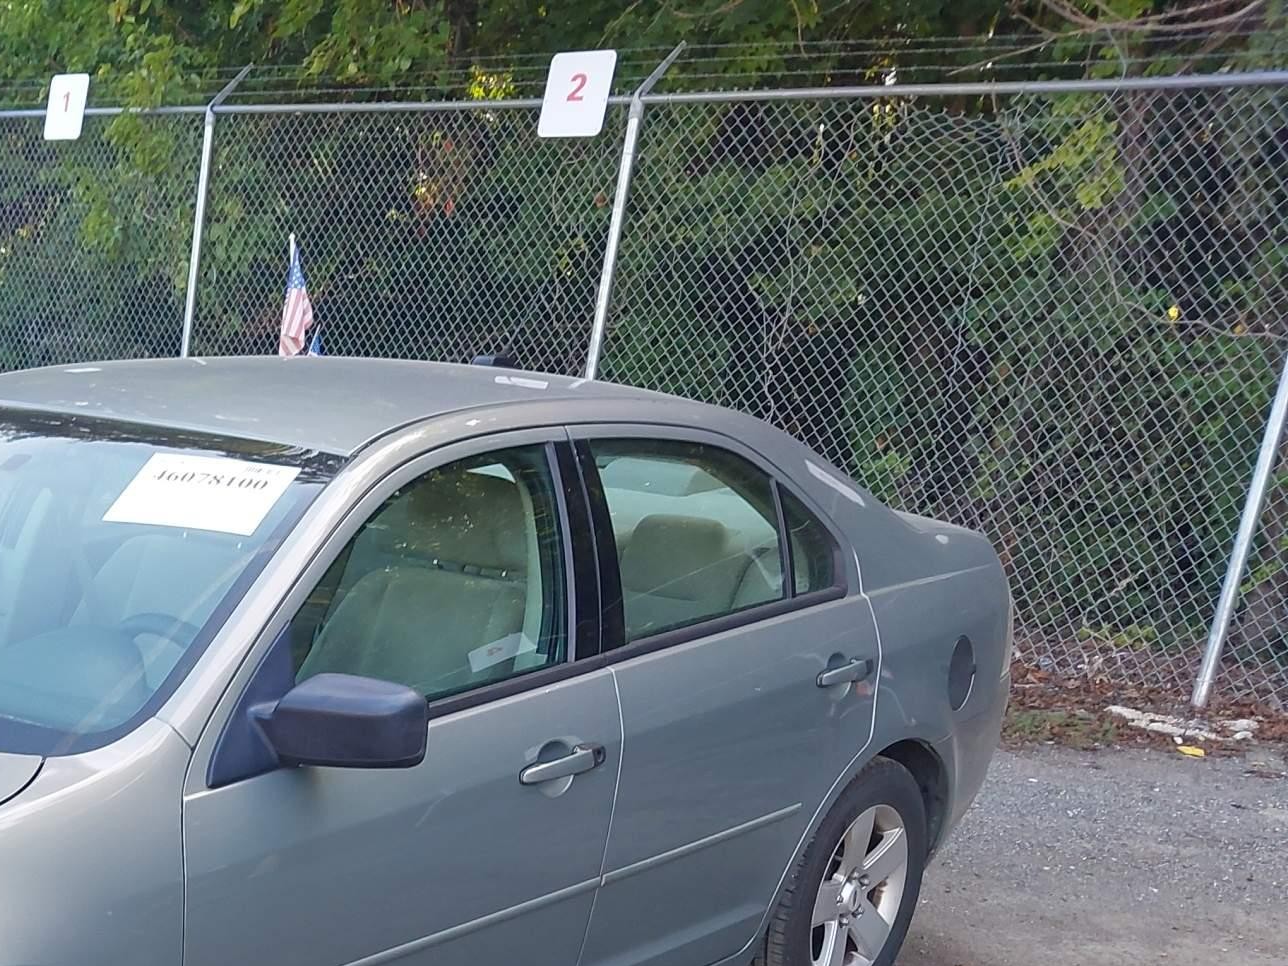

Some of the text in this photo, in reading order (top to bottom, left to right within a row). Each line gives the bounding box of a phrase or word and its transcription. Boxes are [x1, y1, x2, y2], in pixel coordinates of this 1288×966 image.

[566, 73, 588, 102] 2
[63, 90, 71, 113] 1
[153, 470, 269, 490] 46078100
